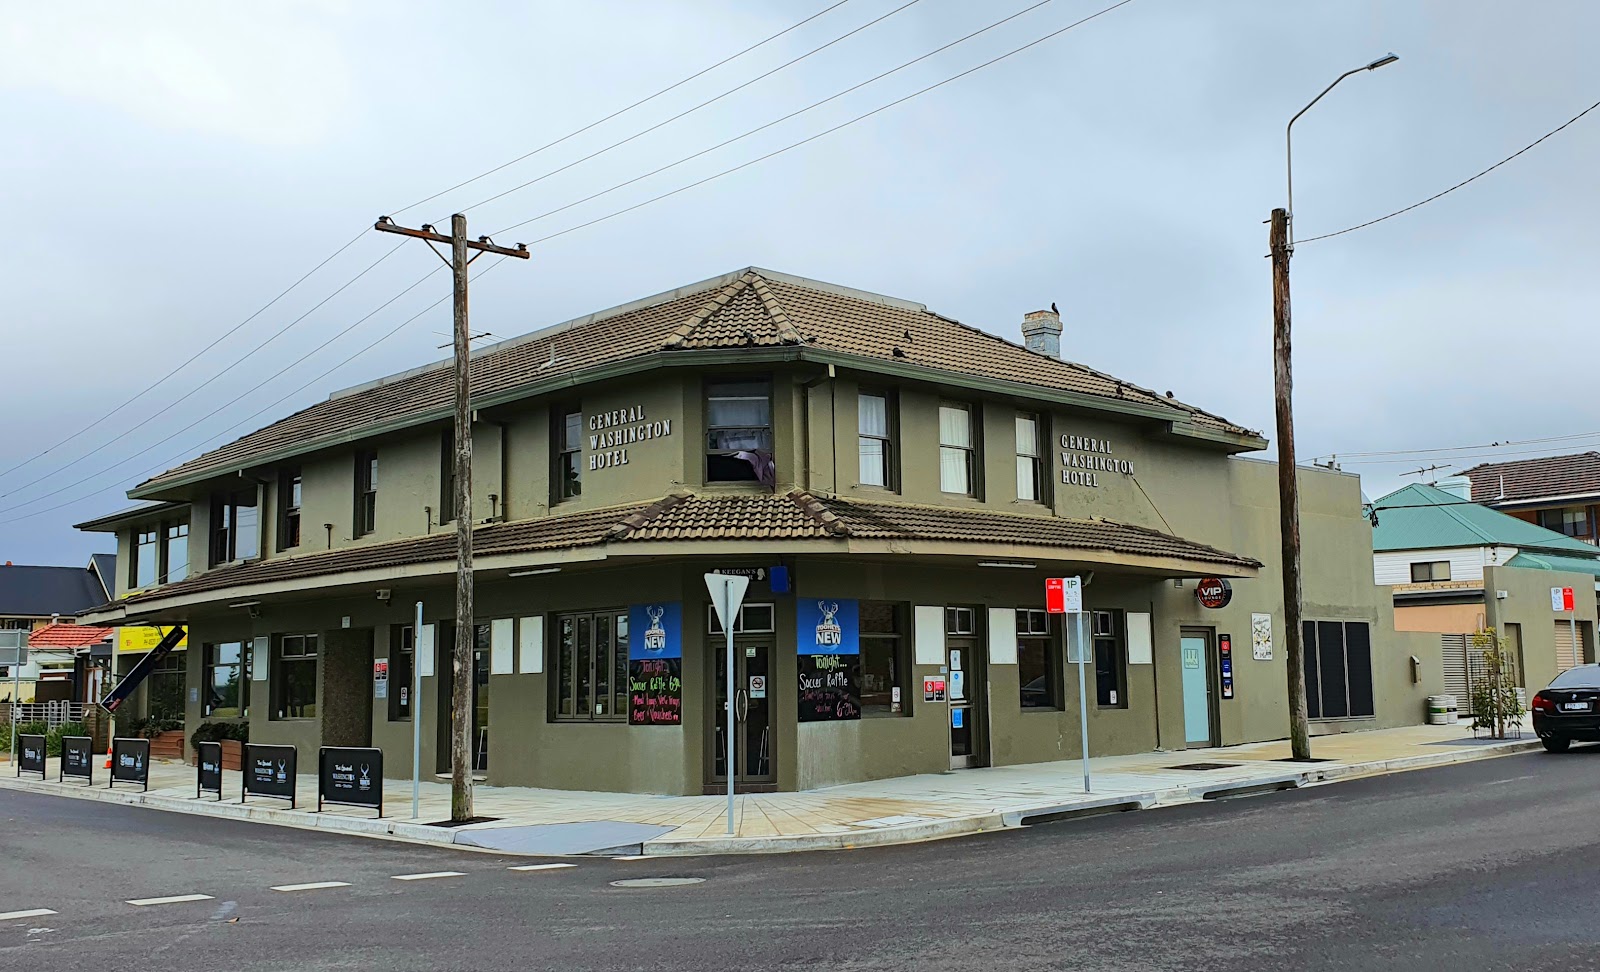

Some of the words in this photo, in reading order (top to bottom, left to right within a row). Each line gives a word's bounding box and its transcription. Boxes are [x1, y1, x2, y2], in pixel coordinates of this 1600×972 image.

[589, 405, 645, 431] GENERAL
[589, 419, 672, 450] WASHINGTON
[1061, 434, 1113, 454] GENERAL
[589, 449, 629, 470] HOTEL
[1061, 452, 1135, 475] WASHINGTON
[1062, 469, 1099, 488] HOTEL
[721, 568, 757, 576] KEEGAN'S
[1067, 580, 1078, 589] 1P
[1201, 587, 1222, 596] VIP
[816, 624, 841, 632] TOOHEYS
[644, 636, 666, 650] NEW
[815, 631, 841, 645] NEW
[799, 672, 824, 691] Soccer
[826, 671, 848, 688] Raffle
